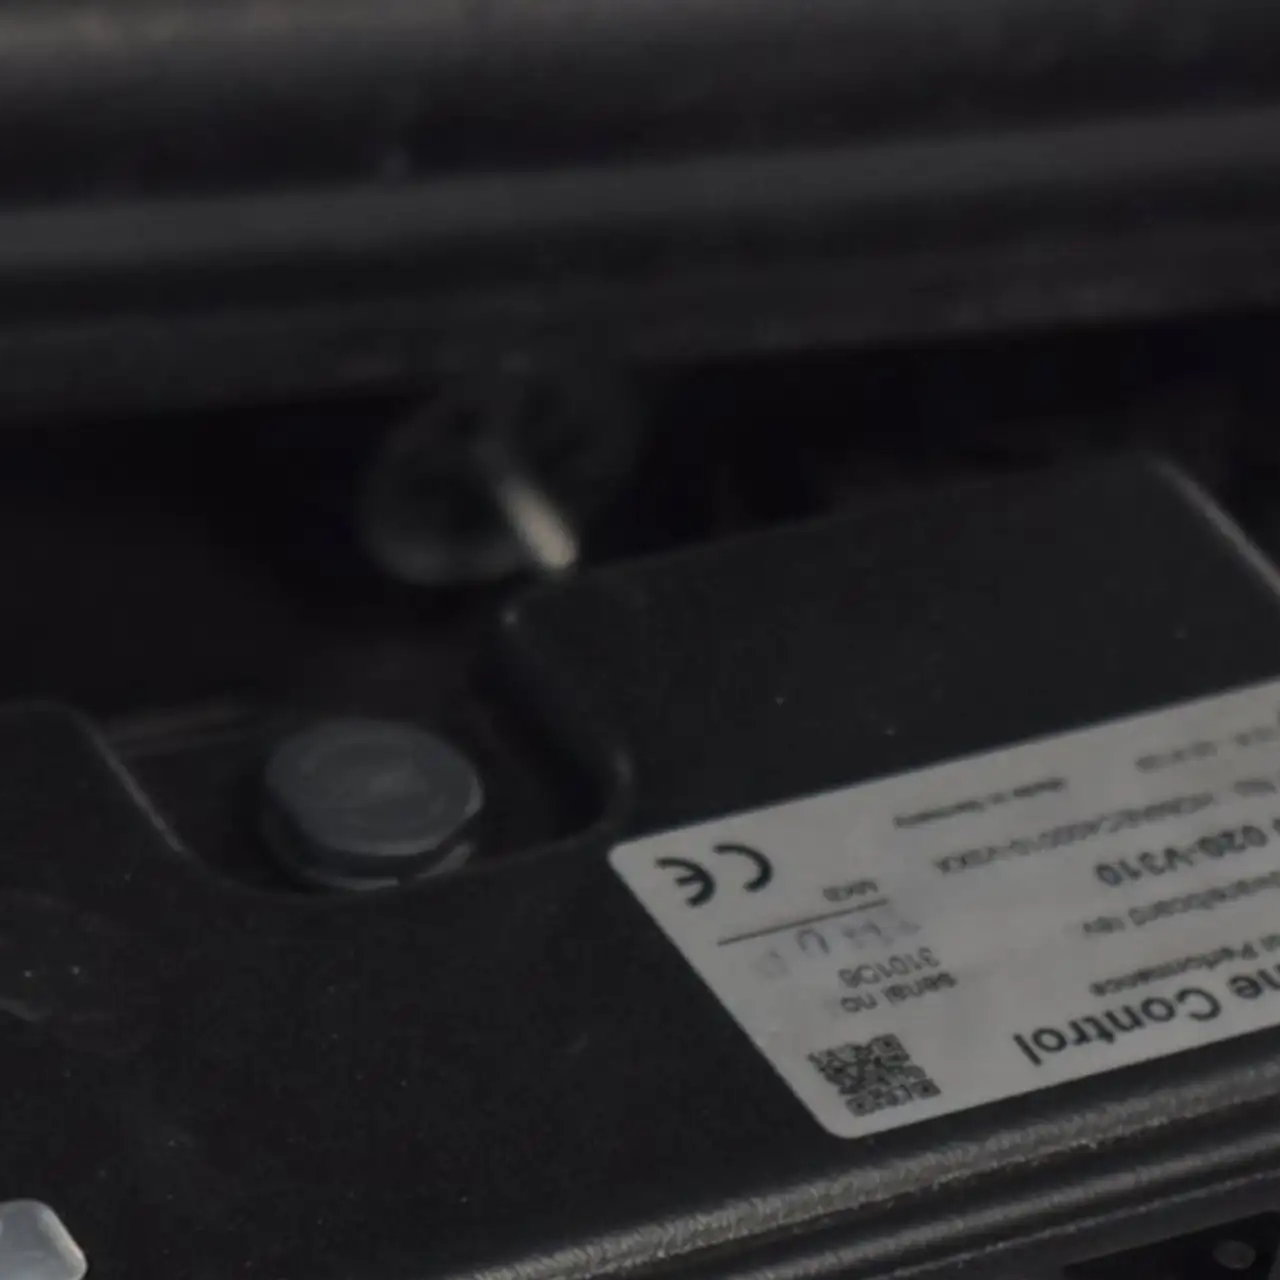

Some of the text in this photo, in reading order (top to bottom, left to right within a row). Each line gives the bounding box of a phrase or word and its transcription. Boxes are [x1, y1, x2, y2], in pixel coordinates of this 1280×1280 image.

[882, 973, 956, 1003] serial
[1090, 943, 1258, 996] Performance
[1013, 988, 1221, 1066] Control
